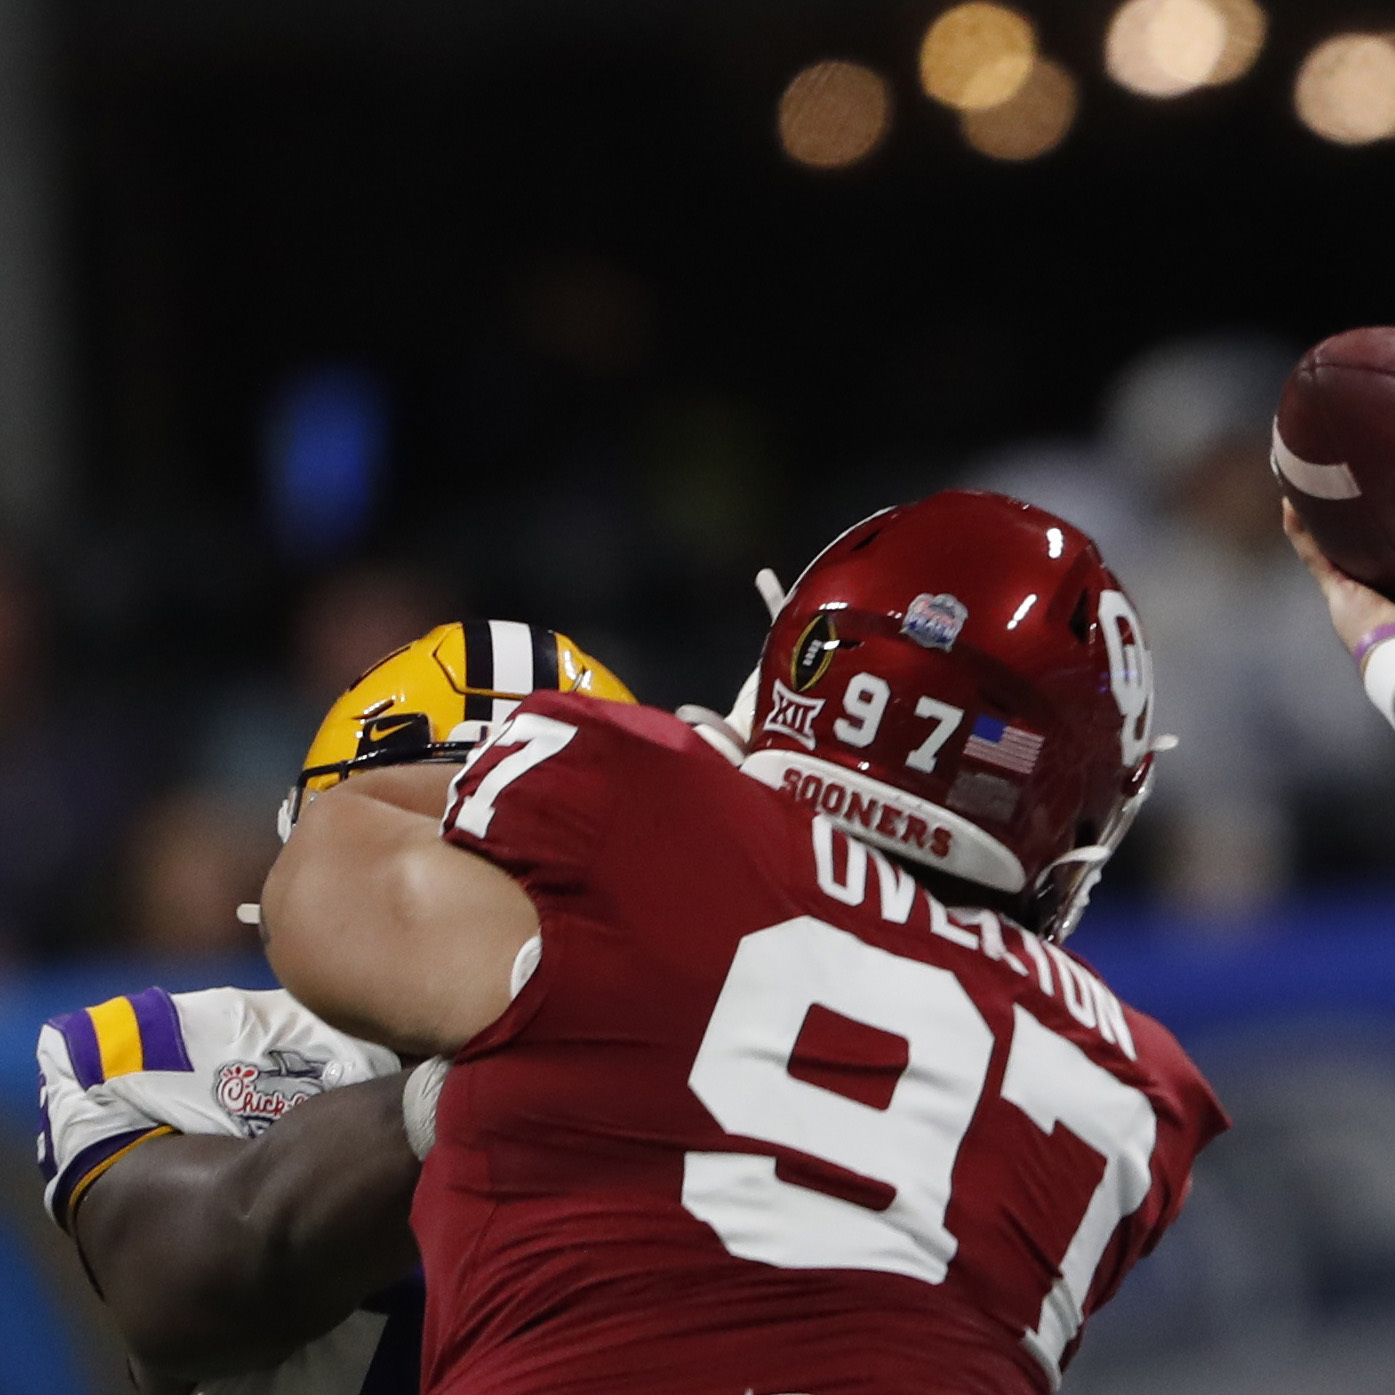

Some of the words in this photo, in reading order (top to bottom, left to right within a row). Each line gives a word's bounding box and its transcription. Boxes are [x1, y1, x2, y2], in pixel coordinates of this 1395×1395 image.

[833, 672, 964, 774] 97
[781, 767, 953, 858] SOONERS
[681, 914, 1158, 1393] 97
